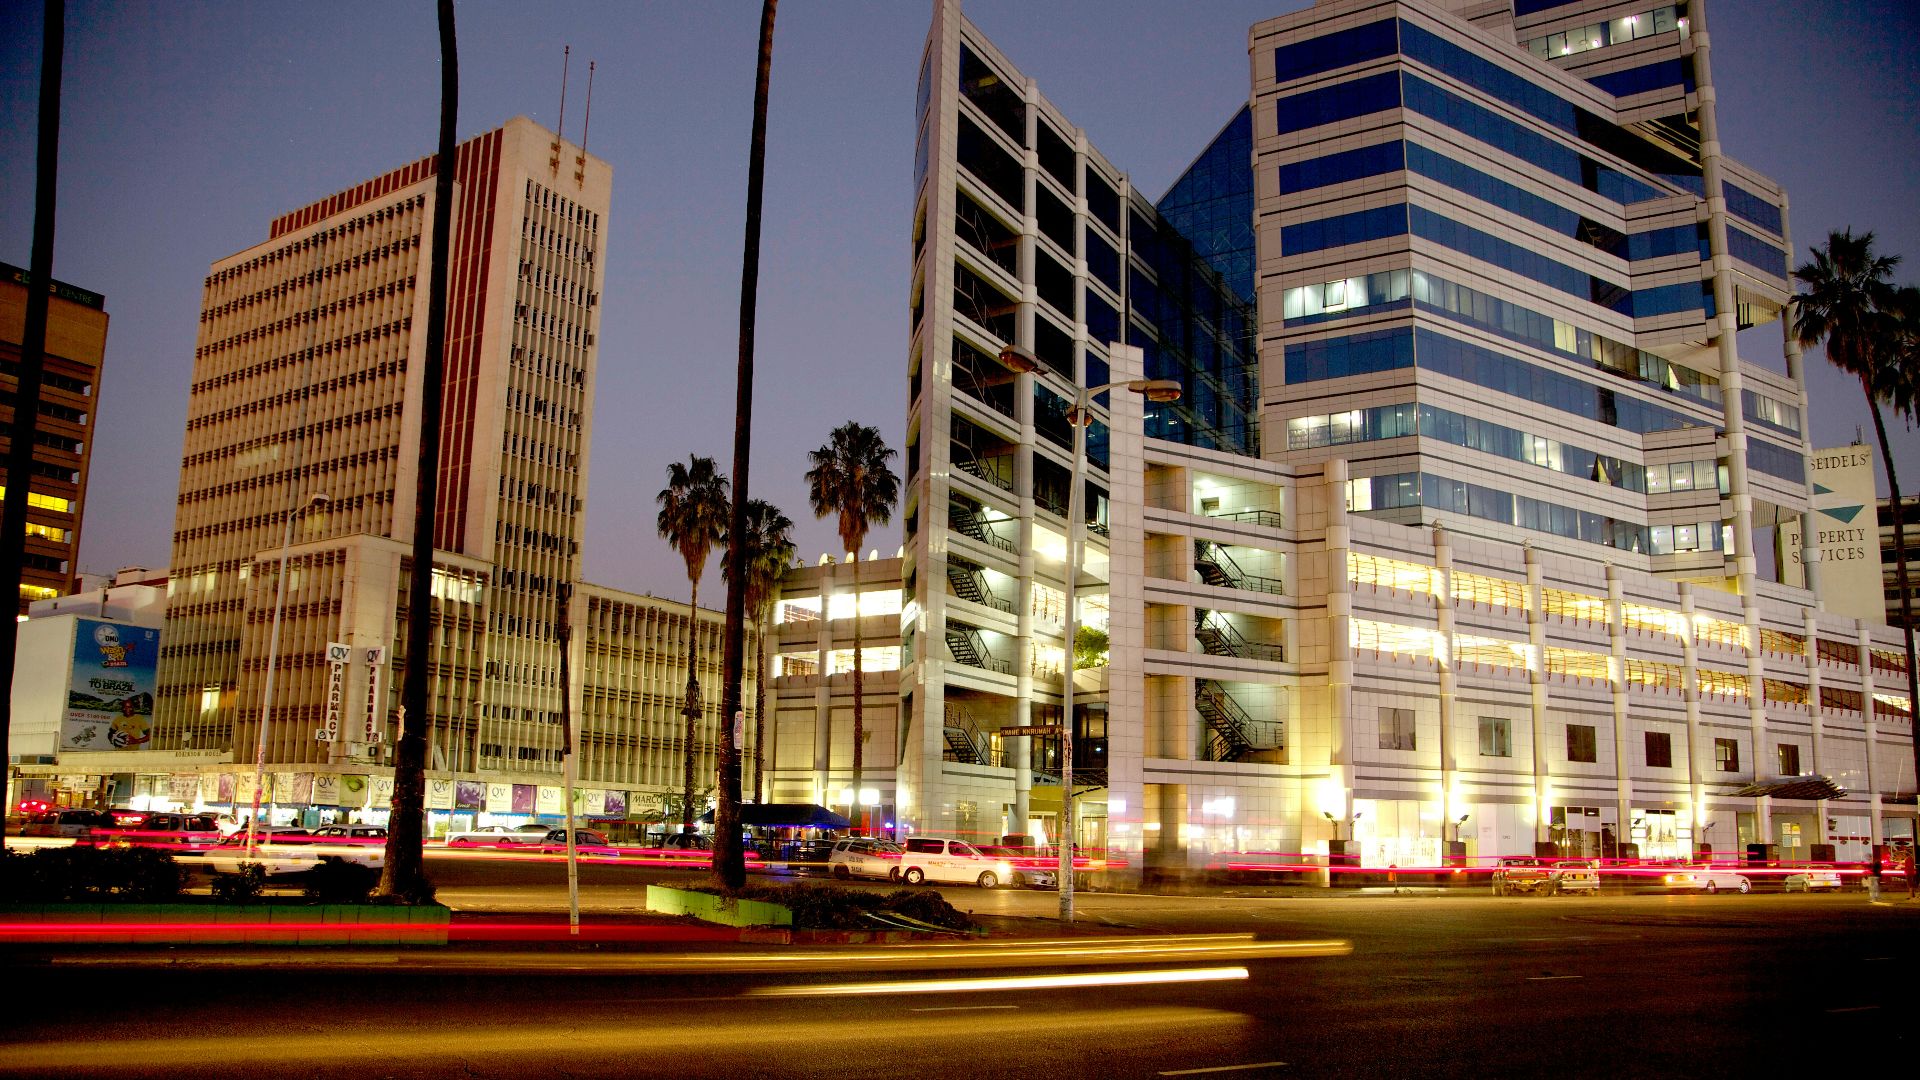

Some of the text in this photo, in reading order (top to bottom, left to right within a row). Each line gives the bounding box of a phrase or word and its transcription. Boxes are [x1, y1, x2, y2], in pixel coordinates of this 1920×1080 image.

[1790, 528, 1865, 545] PPERTY
[1791, 546, 1865, 563] SICES
[105, 635, 119, 643] OMO
[330, 646, 350, 660] QV
[367, 649, 381, 662] QV
[88, 680, 101, 689] TO
[103, 682, 135, 692] BRAZIL
[328, 664, 341, 739] PHARMACY
[365, 667, 376, 741] PHARMACY
[317, 776, 335, 788] QV
[377, 779, 392, 792] QV
[433, 780, 449, 793] QV
[491, 787, 506, 798] QV
[541, 788, 556, 800] QV
[587, 792, 600, 803] QV
[632, 794, 663, 804] MARCO
